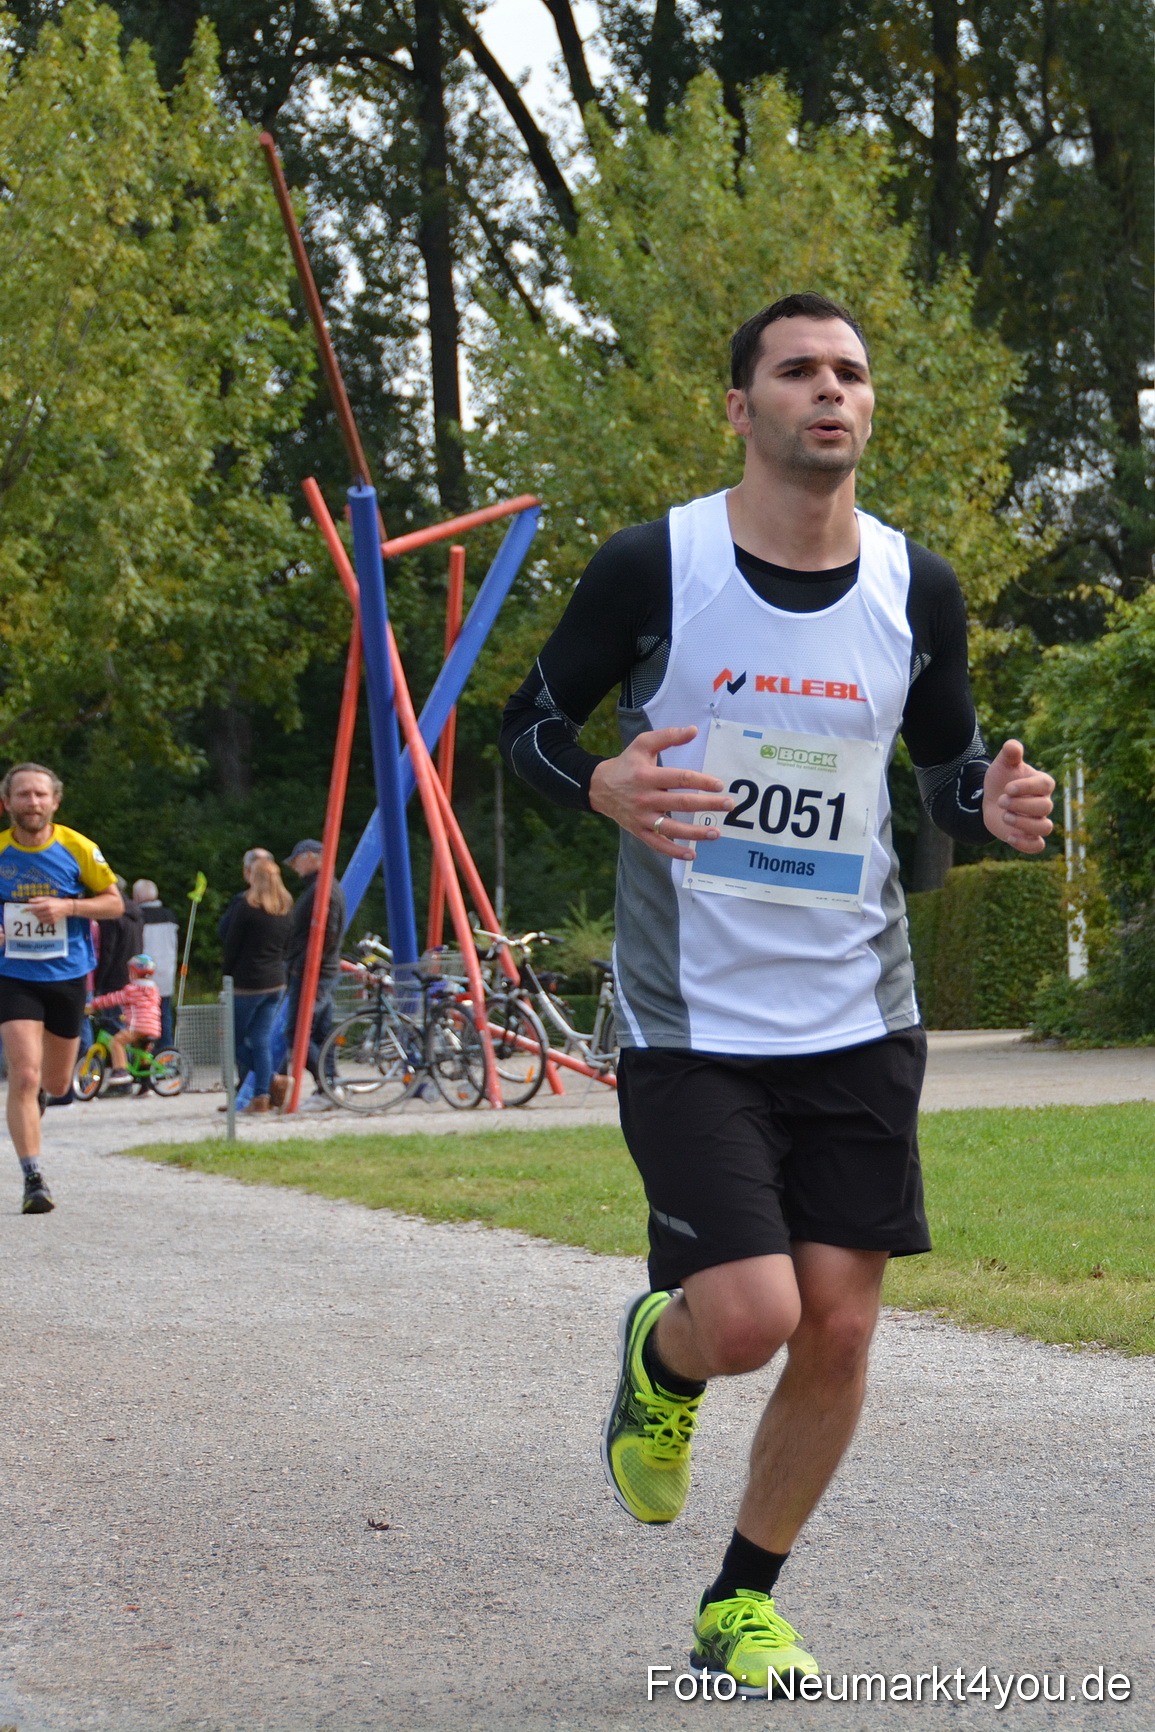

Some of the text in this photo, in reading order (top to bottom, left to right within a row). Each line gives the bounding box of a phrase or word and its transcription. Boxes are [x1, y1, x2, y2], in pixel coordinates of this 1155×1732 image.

[755, 675, 867, 702] KLEBL
[778, 747, 838, 768] BOCK
[704, 816, 711, 826] D
[723, 779, 846, 841] 2051
[747, 850, 816, 877] Thomas
[13, 921, 56, 937] 2144
